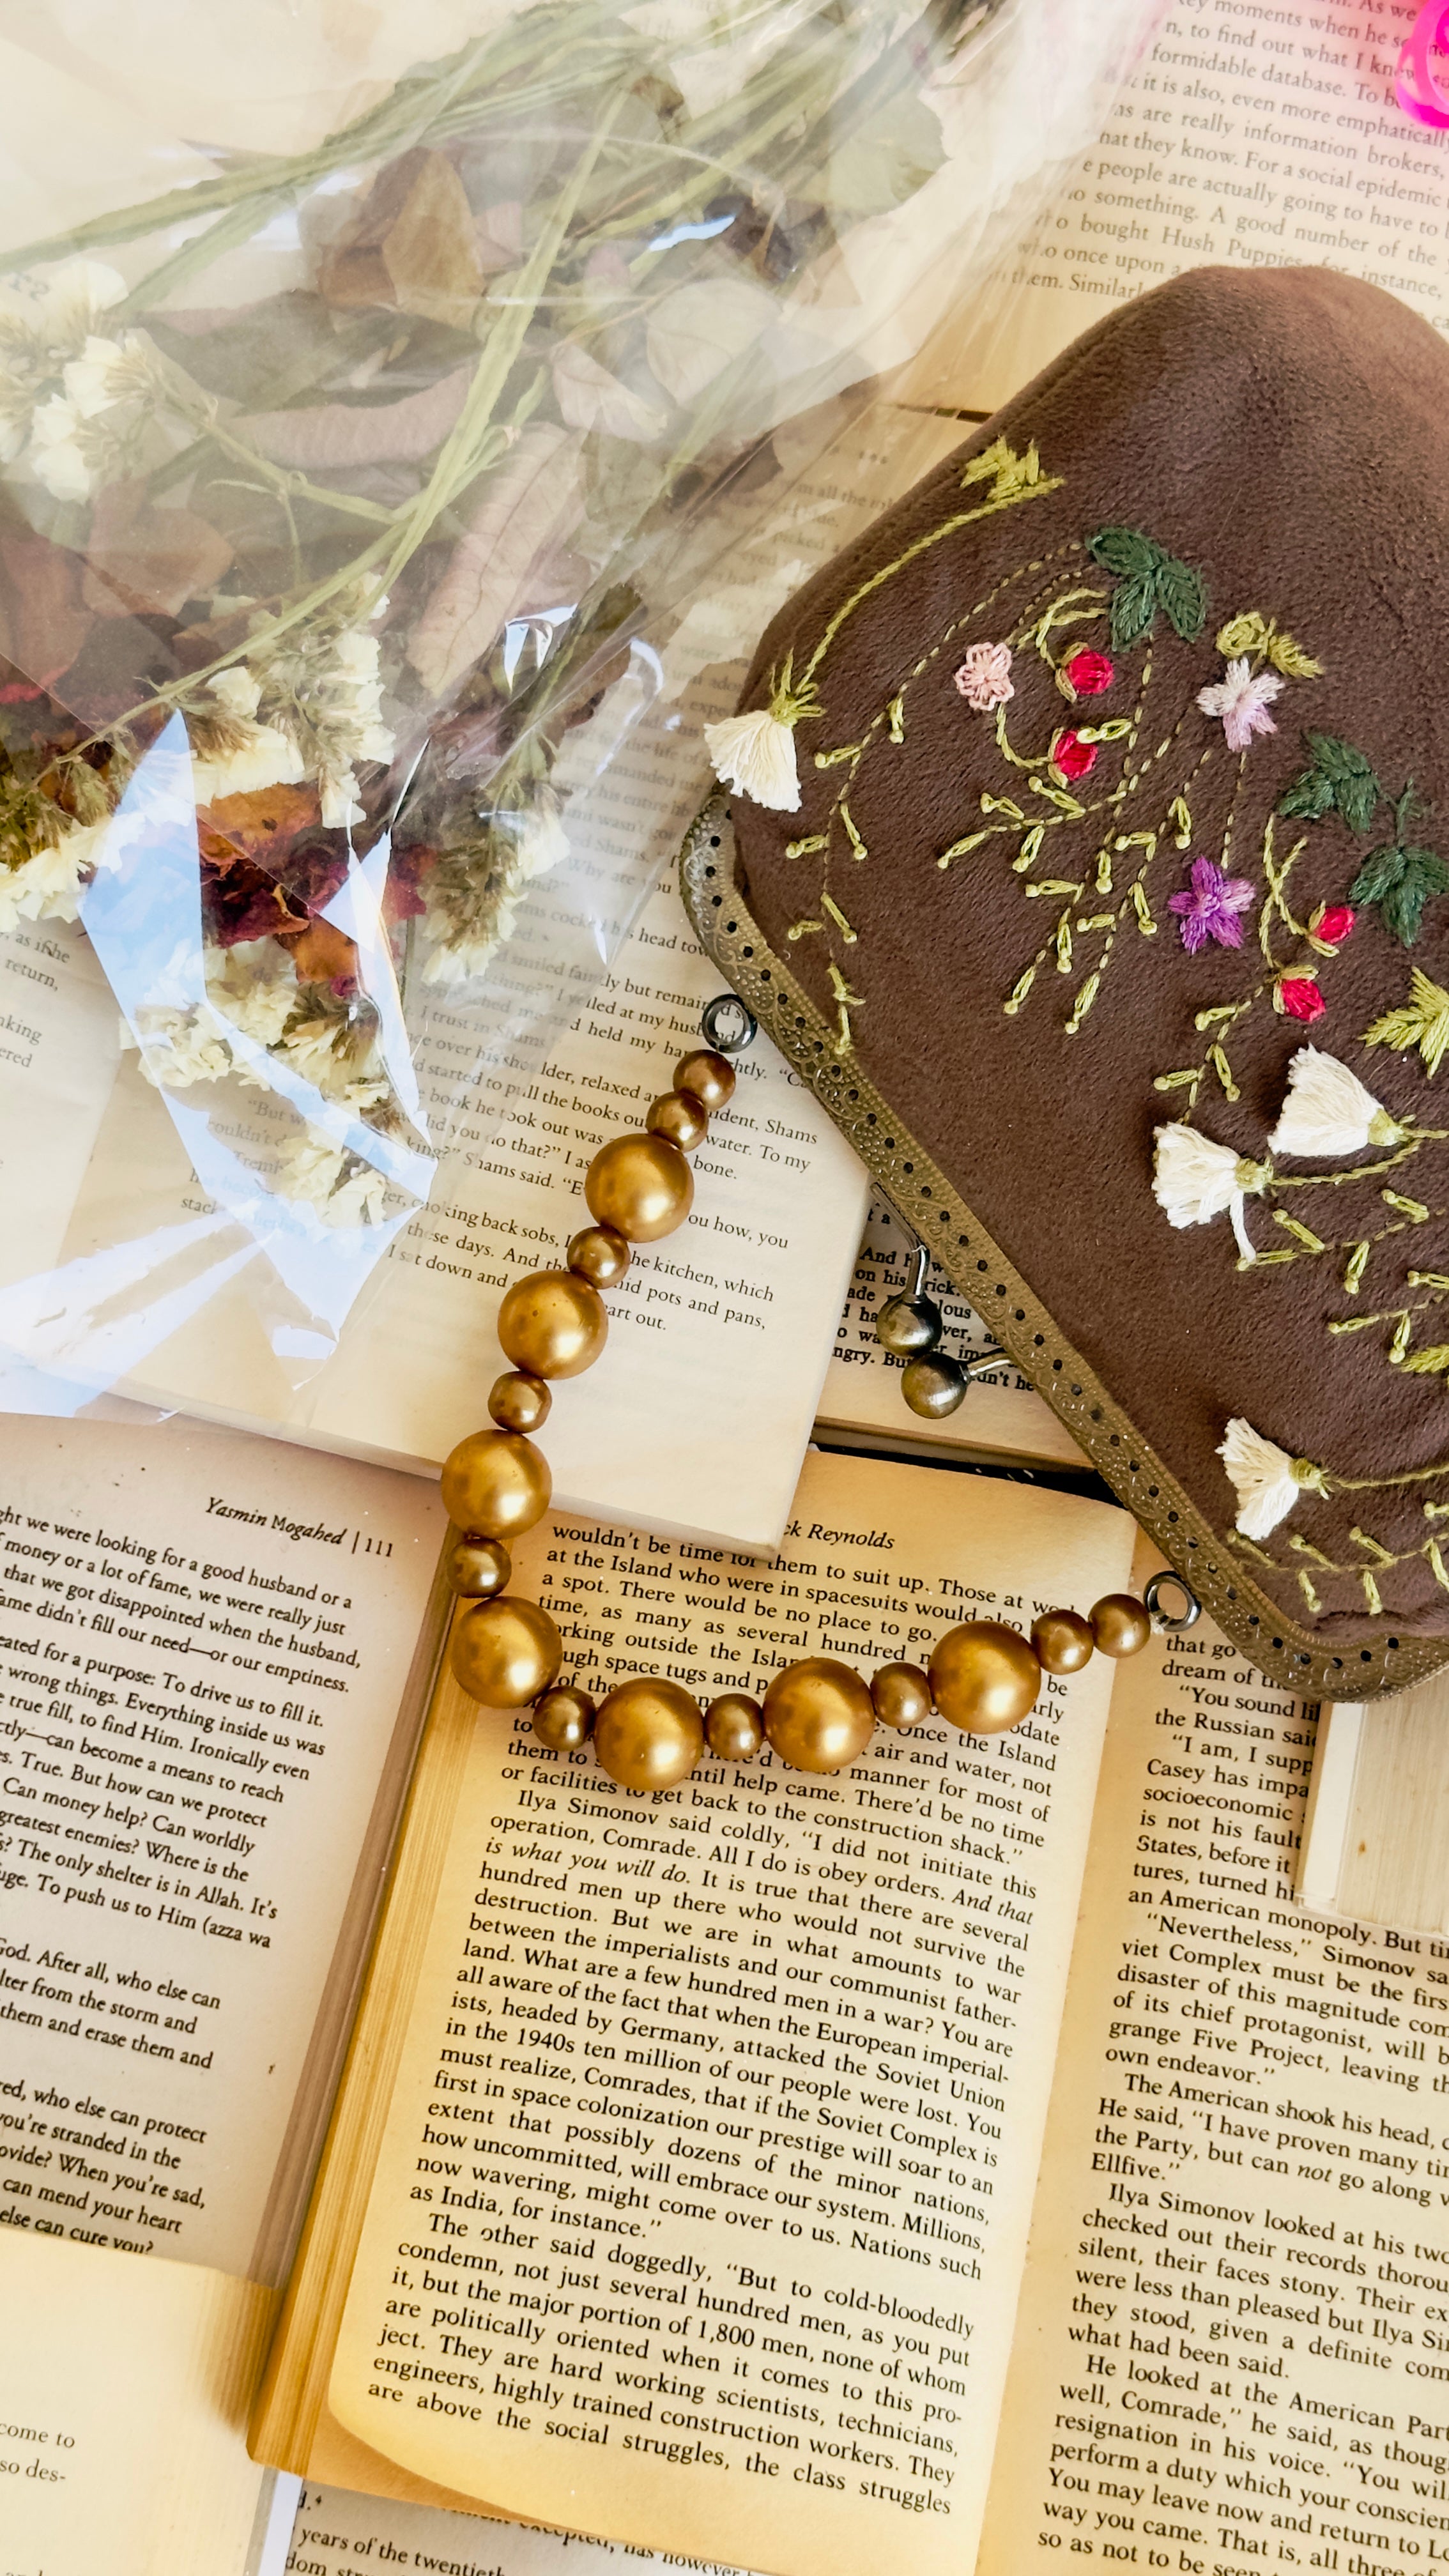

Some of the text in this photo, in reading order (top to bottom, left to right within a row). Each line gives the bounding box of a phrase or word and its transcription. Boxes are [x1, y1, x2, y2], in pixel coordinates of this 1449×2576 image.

[1191, 24, 1364, 70] to find out what I
[1143, 78, 1331, 123] it is also, even more
[1143, 109, 1445, 180] are really information brokers,
[1134, 132, 1441, 206] they know. For a social epidemic
[5, 959, 58, 992] return,
[581, 1076, 640, 1100] relaxed
[765, 1119, 818, 1144] Shams
[694, 1154, 737, 1179] bone.
[706, 1135, 811, 1173] water. To my
[481, 1212, 559, 1247] back sobs,
[713, 1216, 788, 1249] how, you
[456, 1235, 540, 1267] days. And
[859, 1246, 896, 1264] And
[653, 1257, 773, 1301] kitchen, which
[855, 1269, 907, 1286] on his
[636, 1313, 666, 1330] out.
[647, 1288, 765, 1330] pots and pans,
[206, 1497, 393, 1557] Yasmin Mogahed 111
[808, 1524, 895, 1549] Reynolds
[27, 1517, 351, 1609] we were looking for a good husband or a
[43, 1643, 323, 1727] for a purpose: To drive us to fill it.
[1156, 1708, 1274, 1740] the Russian
[1147, 1759, 1248, 1787] Casey has
[486, 1837, 1028, 1951] is what you will do. It is true that there are several
[31, 1977, 197, 2034] from the storm and
[1117, 1963, 1400, 2028] disaster of this magnitude
[445, 2018, 1000, 2139] in the 1940s ten million of our people were lost. You
[34, 2087, 207, 2143] who else can protect
[1096, 2125, 1431, 2207] the Party, but can not go along
[3, 2179, 182, 2234] can mend your heart
[410, 2186, 433, 2202] as
[441, 2186, 503, 2216] India,
[512, 2197, 544, 2220] for
[392, 2266, 965, 2396] it, but the major portion of 1,800 men, none of whom
[56, 2433, 75, 2448] to
[368, 2384, 950, 2514] are above the social struggles, the class struggles
[26, 2458, 66, 2482] des-
[1049, 2467, 1420, 2555] You may leave now and return to
[298, 2529, 408, 2563] years of the
